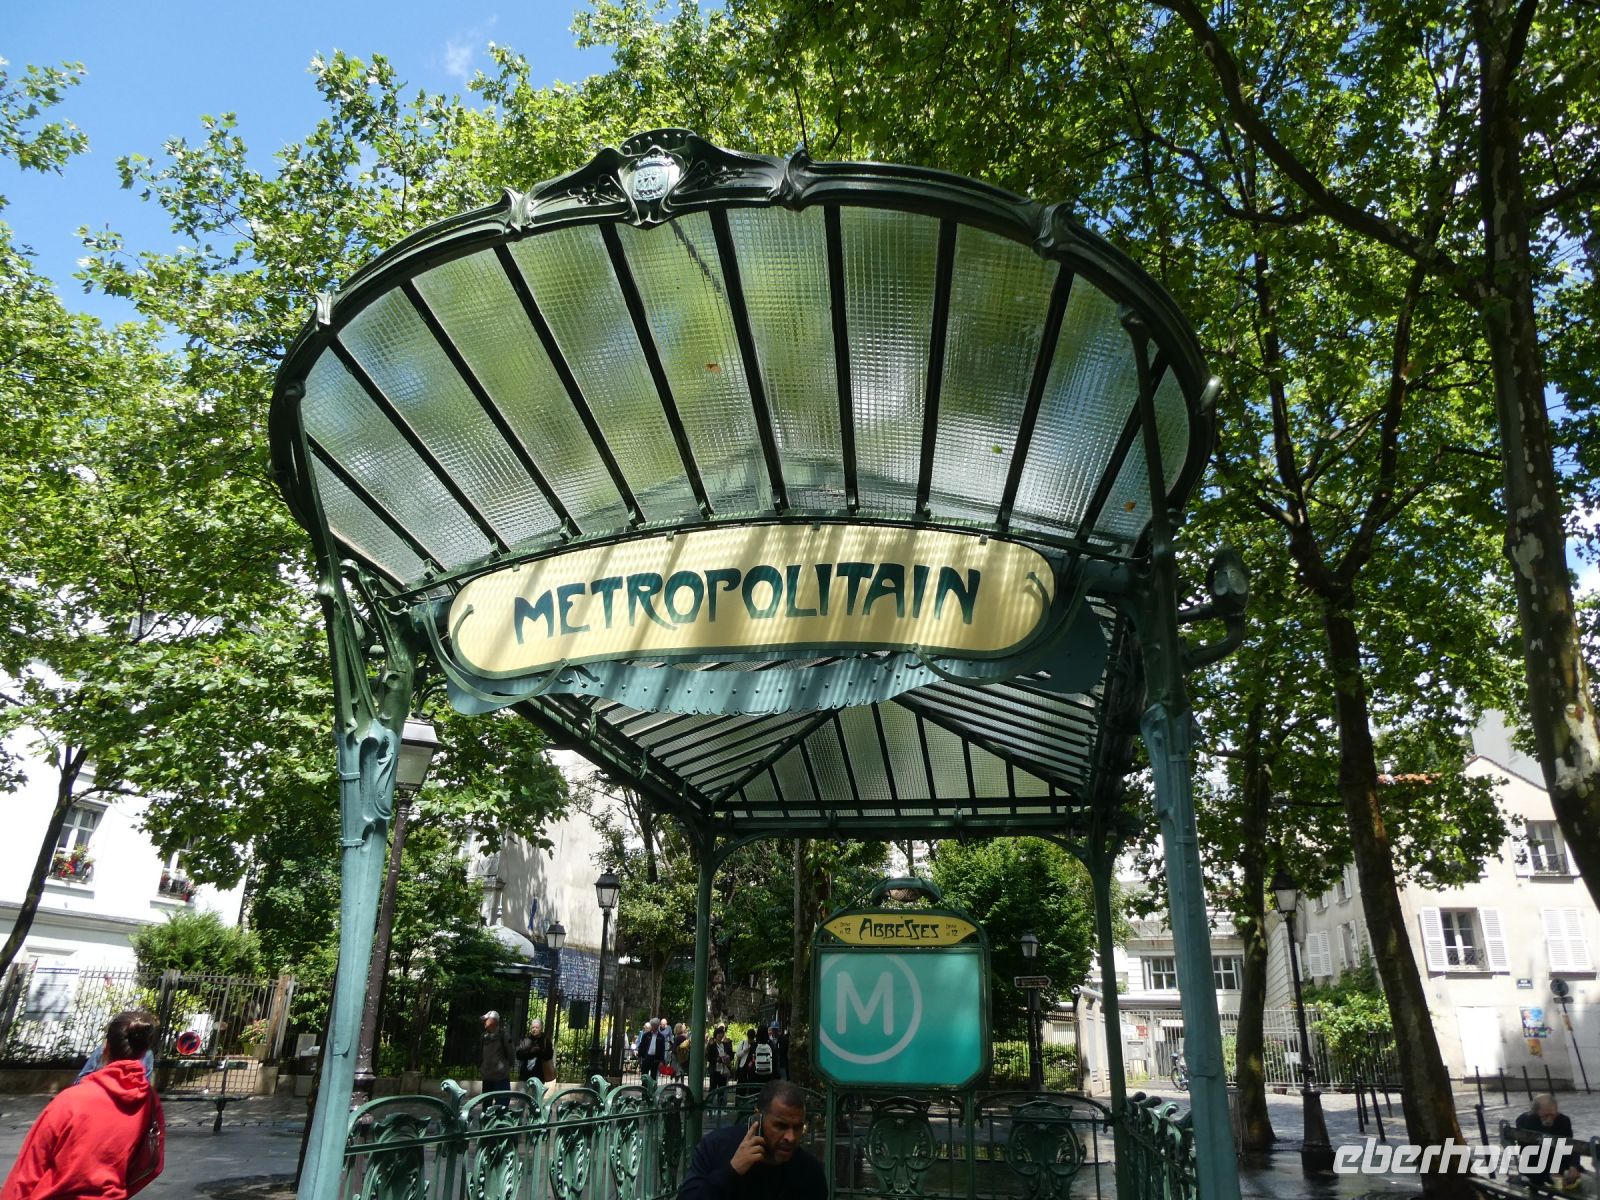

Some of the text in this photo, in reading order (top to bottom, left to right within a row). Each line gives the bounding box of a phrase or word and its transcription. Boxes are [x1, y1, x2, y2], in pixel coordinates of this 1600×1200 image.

[513, 562, 981, 645] METROPOLITAIN
[859, 917, 939, 940] ABBESSES
[836, 971, 894, 1036] M
